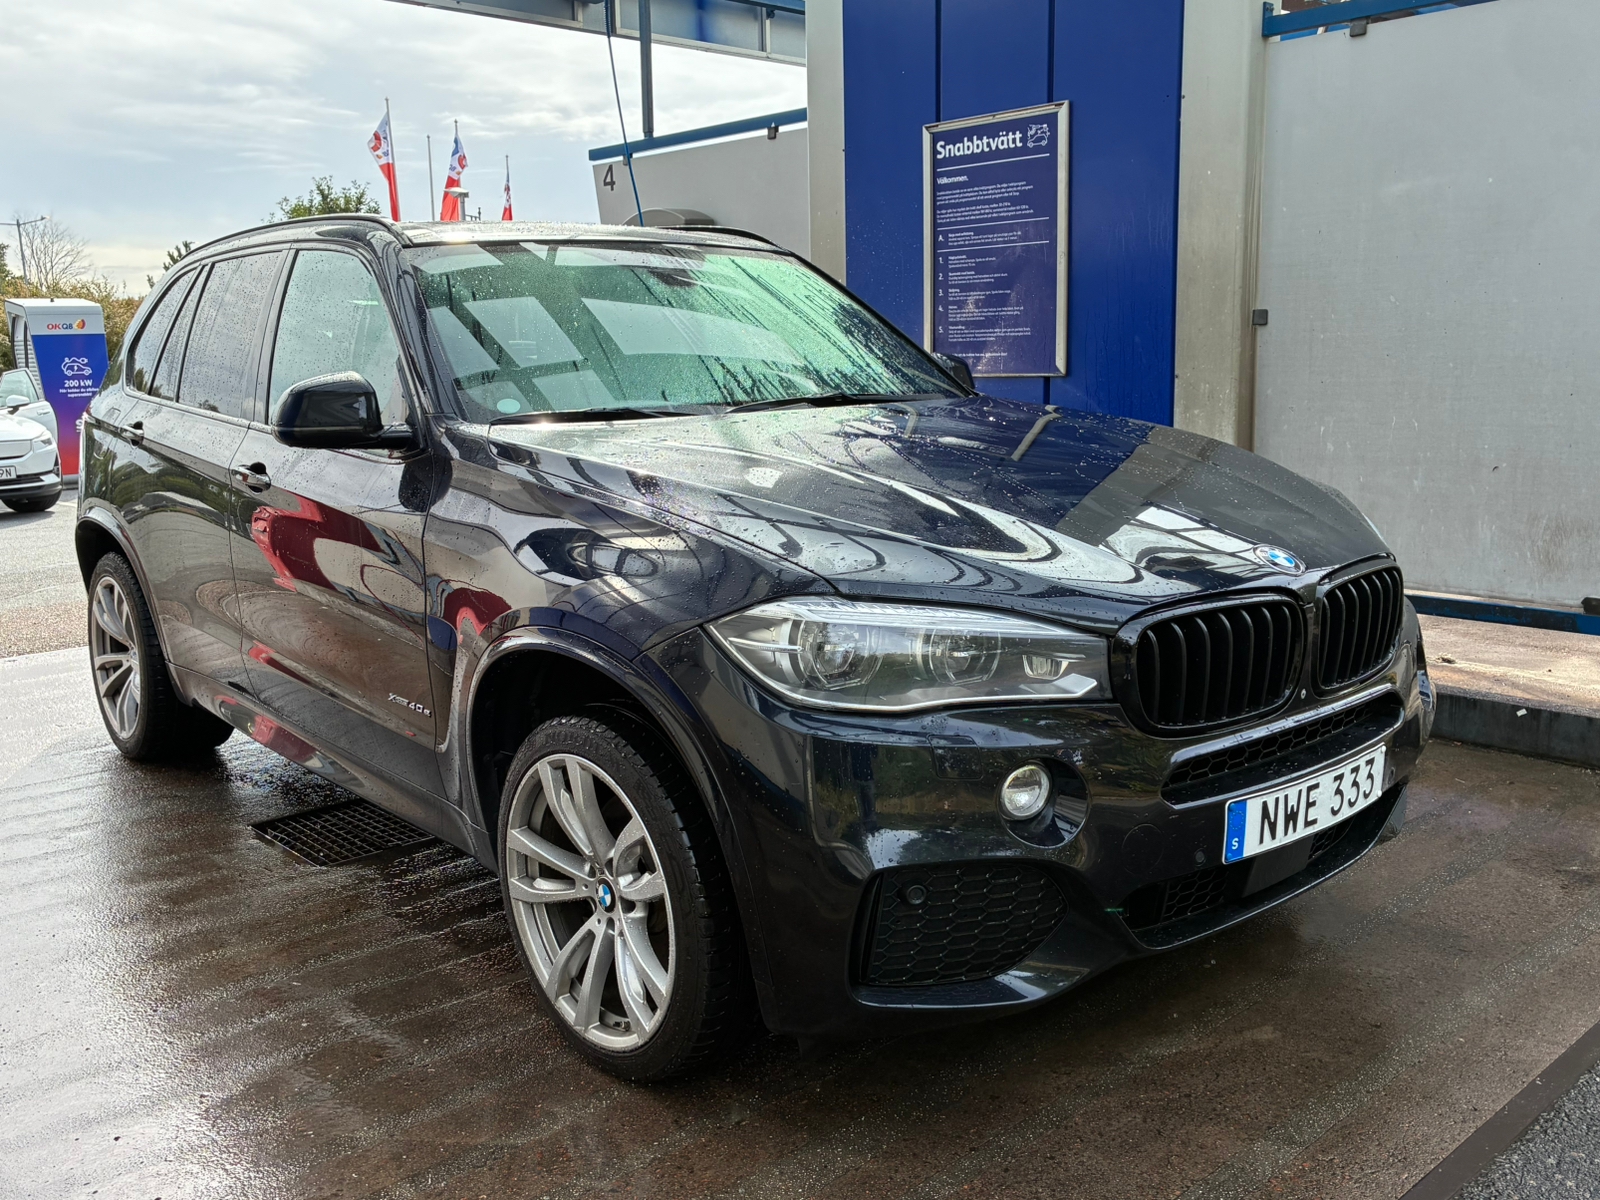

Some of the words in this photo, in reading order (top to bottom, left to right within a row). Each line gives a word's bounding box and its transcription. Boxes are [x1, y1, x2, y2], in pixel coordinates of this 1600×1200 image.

[936, 130, 1023, 160] Snabbtvätt
[603, 164, 616, 191] 4
[64, 379, 79, 387] 200
[80, 379, 93, 387] kW
[1258, 781, 1321, 846] NWE
[1330, 757, 1377, 817] 333
[1231, 837, 1239, 850] S
